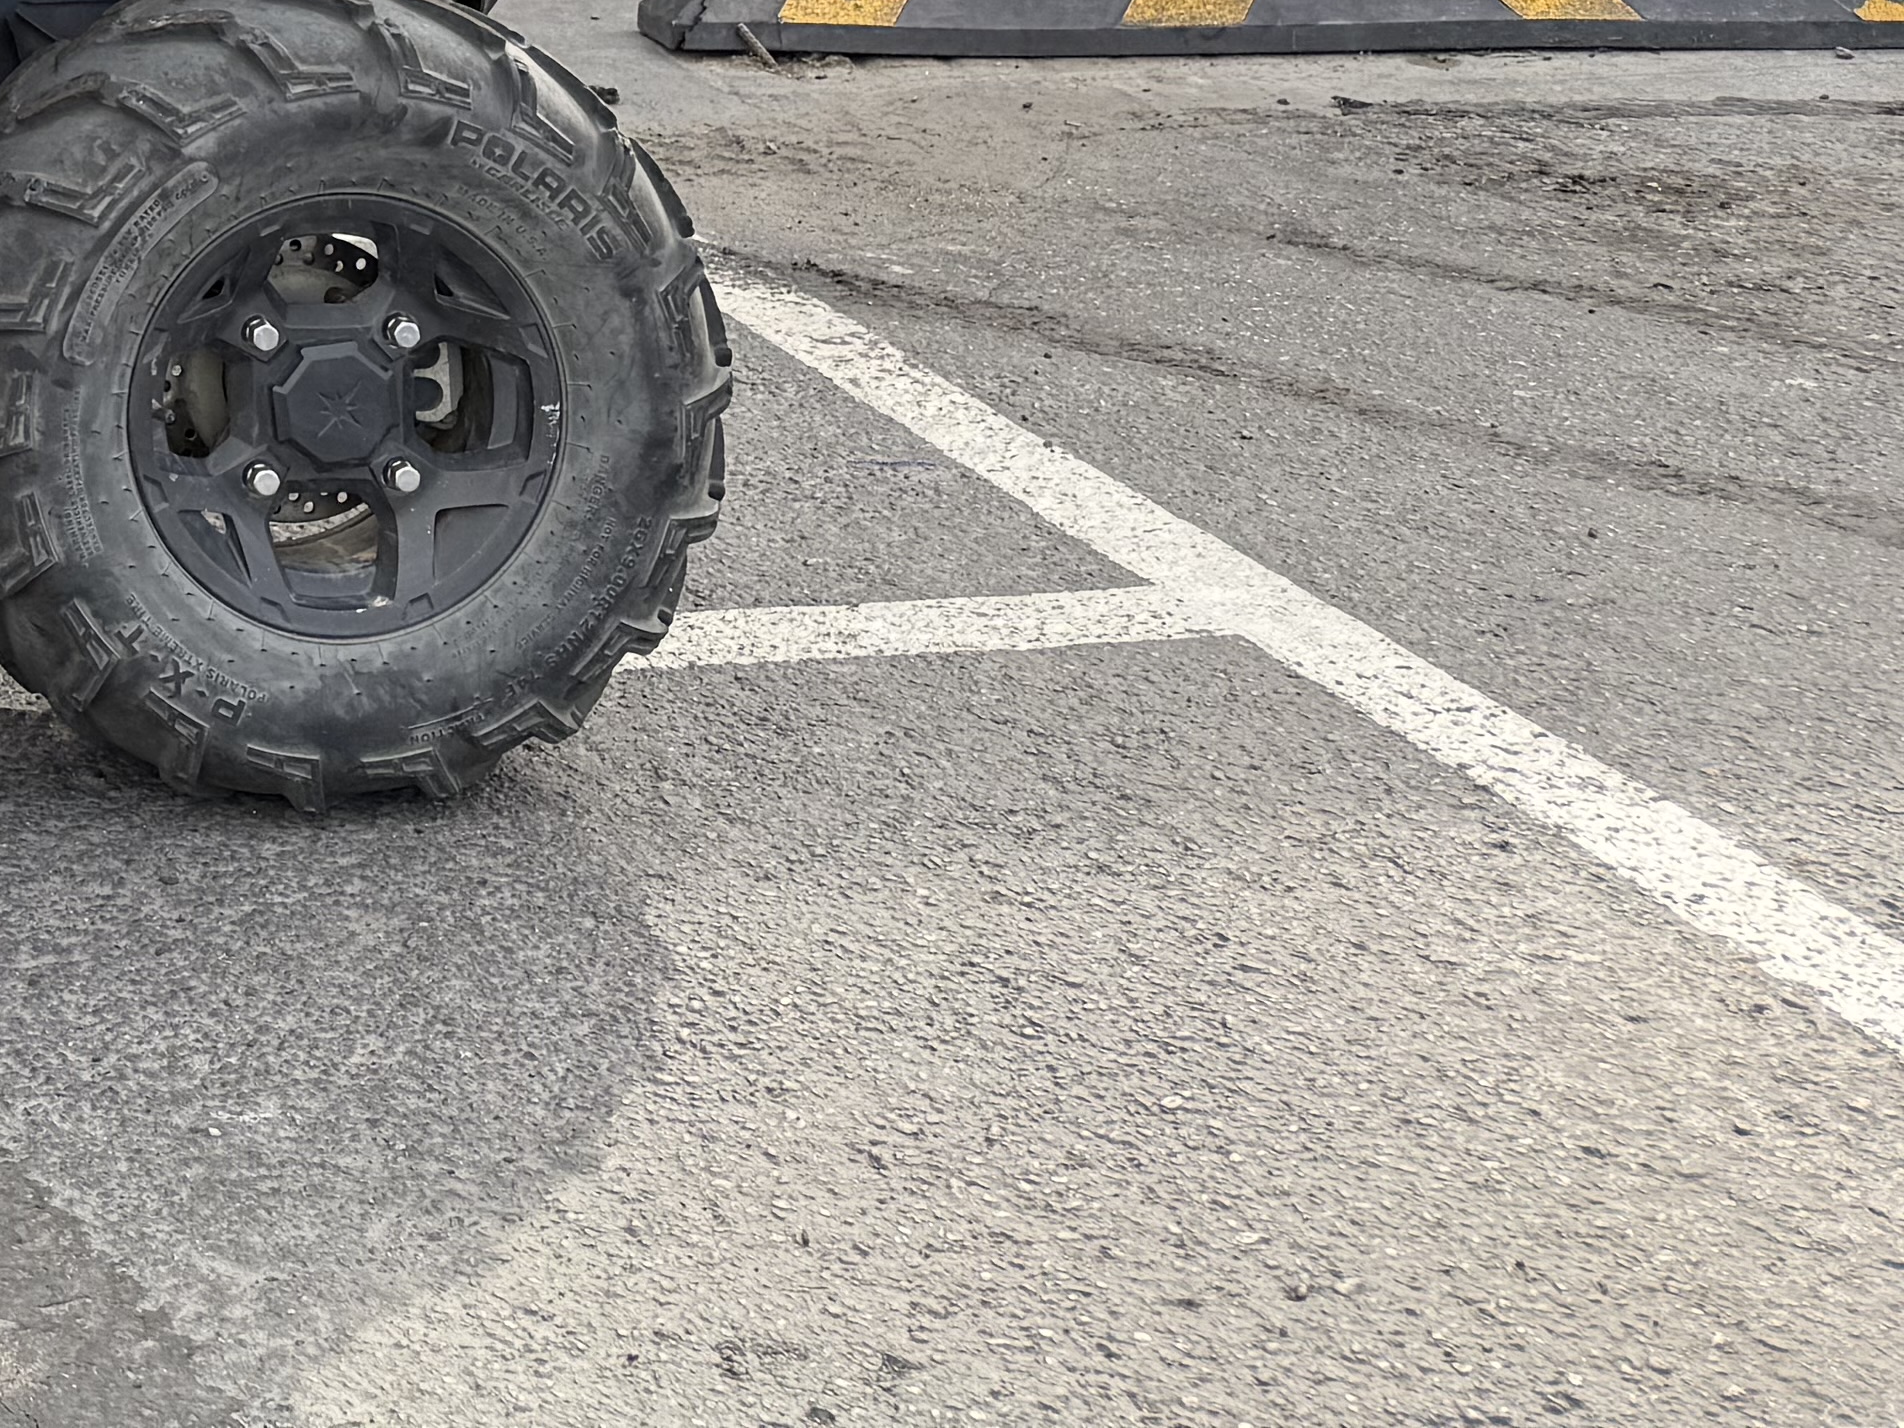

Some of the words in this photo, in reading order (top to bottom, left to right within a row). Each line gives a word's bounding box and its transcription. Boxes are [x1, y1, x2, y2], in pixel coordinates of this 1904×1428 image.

[450, 119, 619, 261] POLARIS
[125, 593, 153, 627] TIRE
[151, 625, 204, 670] XTREME
[204, 664, 270, 703] POLARIS
